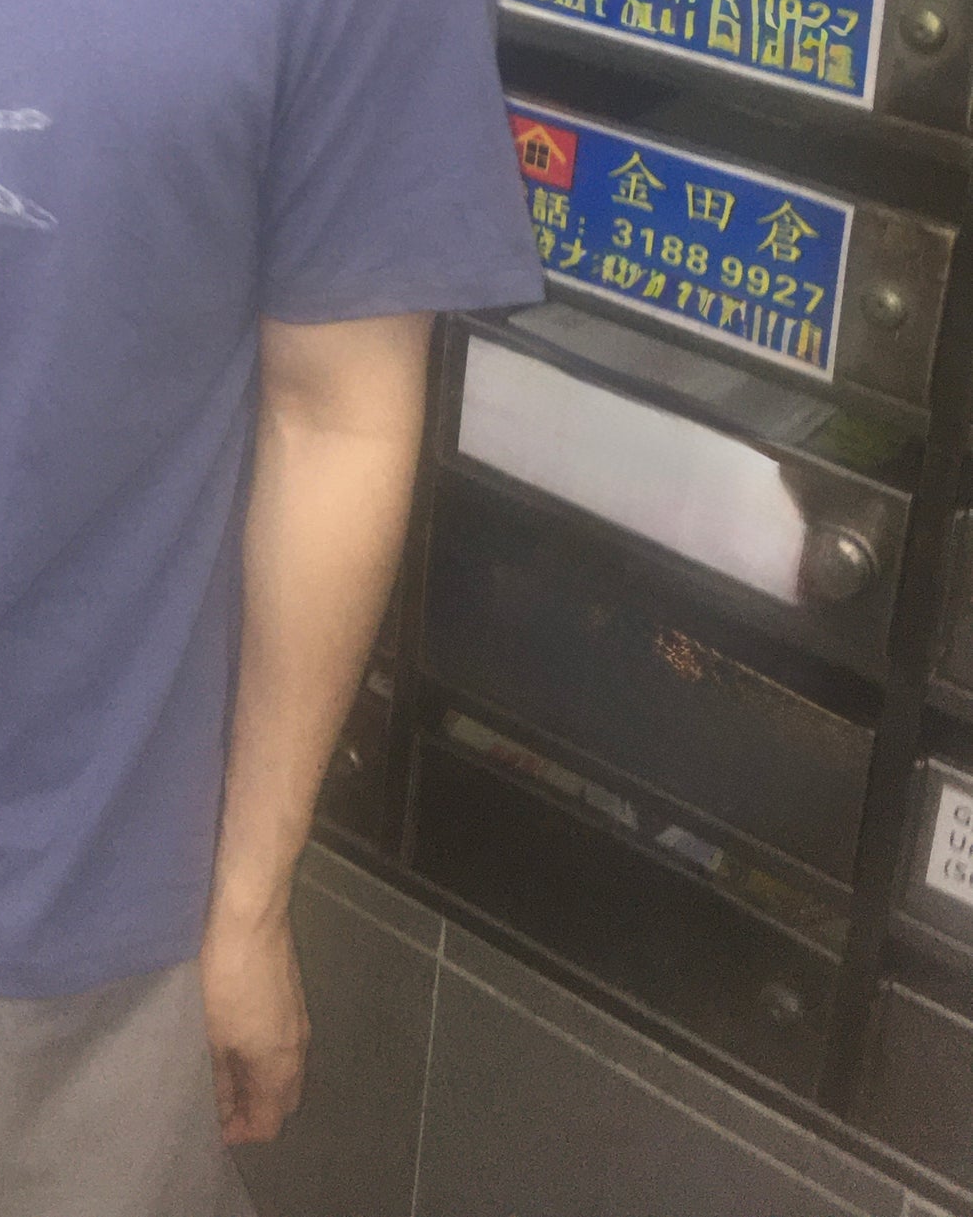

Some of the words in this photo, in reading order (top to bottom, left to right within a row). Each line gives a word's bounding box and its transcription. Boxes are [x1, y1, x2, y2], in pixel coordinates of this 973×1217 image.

[609, 152, 820, 263] 金田倉
[612, 217, 709, 276] 3188
[721, 256, 825, 314] 9927
